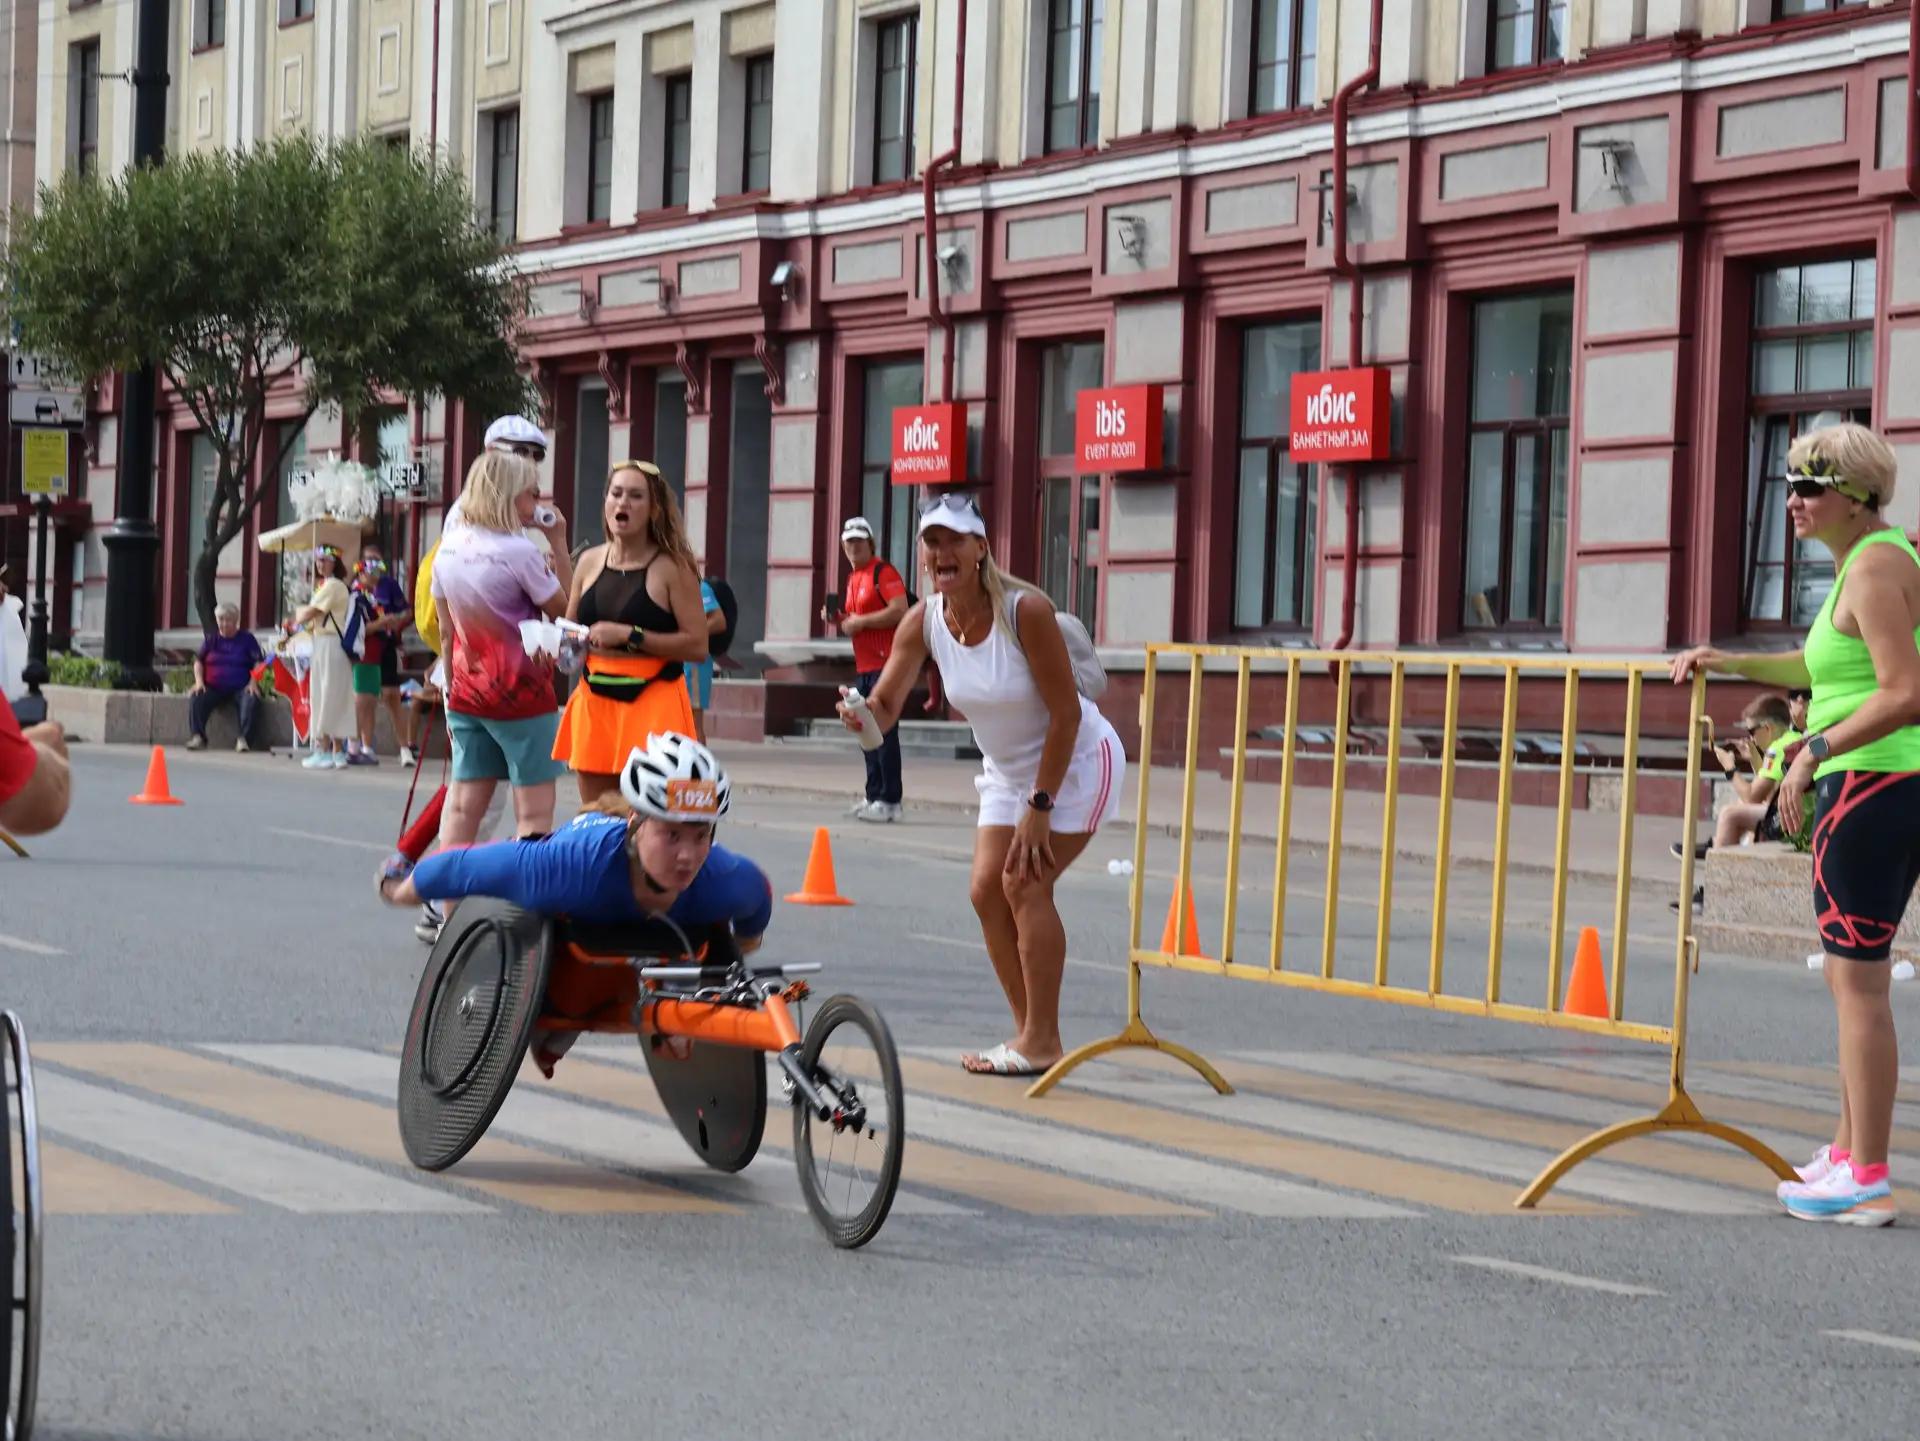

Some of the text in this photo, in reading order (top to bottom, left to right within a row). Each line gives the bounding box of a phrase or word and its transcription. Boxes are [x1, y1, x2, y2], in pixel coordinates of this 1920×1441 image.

[1096, 399, 1125, 437] ibis
[1307, 383, 1356, 425] ибис
[904, 415, 939, 452] ибис
[1085, 440, 1136, 460] EVENT ROOM
[675, 789, 714, 808] 1024
